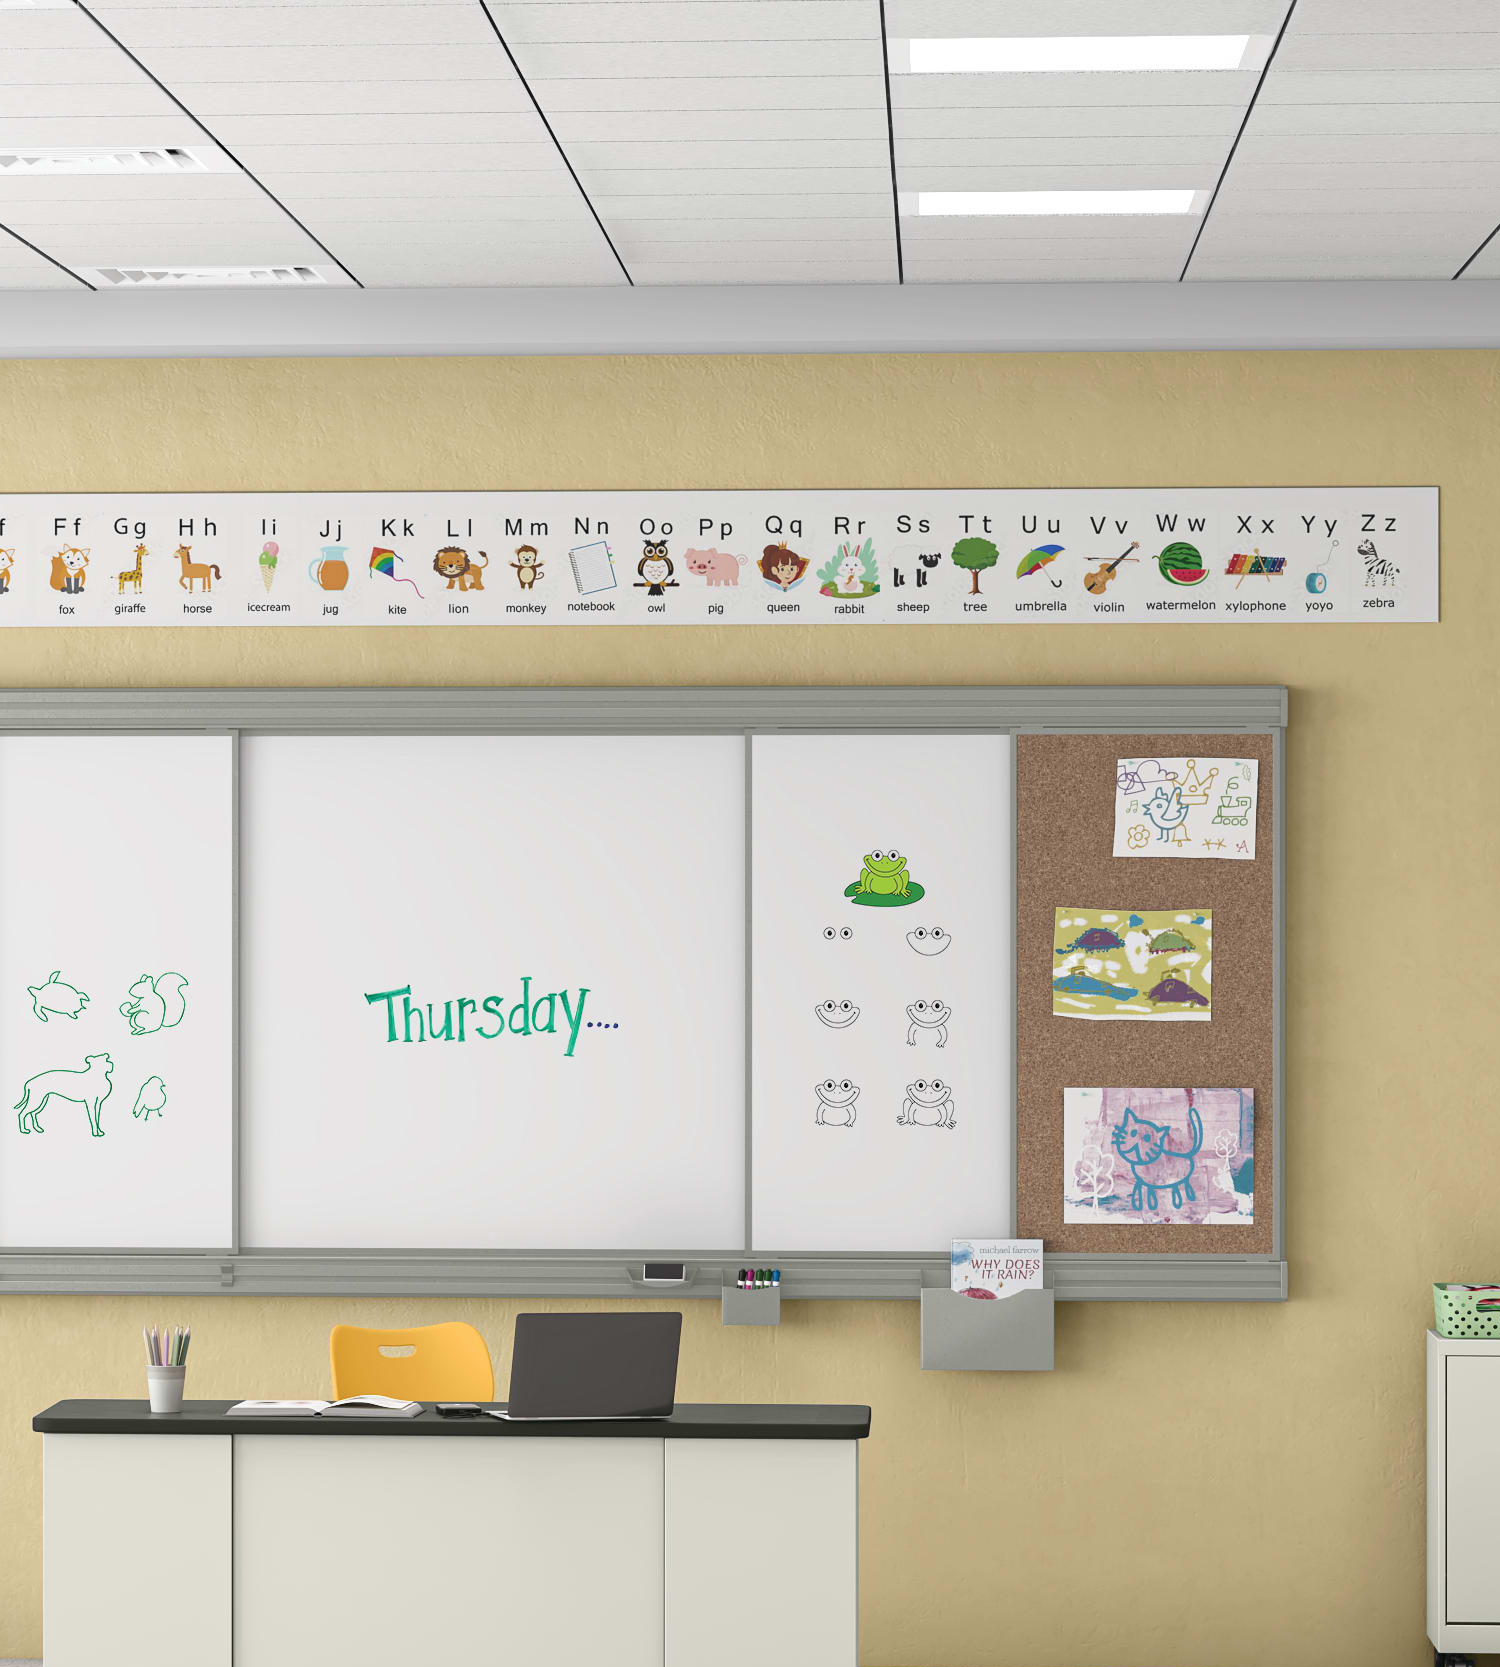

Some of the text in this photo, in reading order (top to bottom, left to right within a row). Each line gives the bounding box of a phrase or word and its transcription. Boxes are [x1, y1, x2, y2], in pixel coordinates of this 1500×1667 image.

[115, 602, 146, 615] giraffe
[183, 604, 212, 613] horse
[248, 603, 290, 612] icecream
[322, 603, 339, 615] jug
[388, 604, 407, 614] kite
[449, 603, 469, 613] lion
[506, 603, 546, 615] monkey
[567, 602, 615, 612] notebook
[648, 602, 665, 612] owl
[708, 603, 724, 615] pig
[767, 604, 800, 614] queen
[897, 602, 930, 614] sheep
[963, 602, 988, 611] tree
[1015, 600, 1067, 611] umbrella
[1094, 602, 1125, 612] violin
[1146, 600, 1216, 610] watermelon
[1226, 601, 1287, 614] xylophone
[1306, 602, 1333, 614] yoyo
[1363, 598, 1395, 609] zebra
[59, 605, 75, 614] fox
[834, 604, 865, 615] rabbit
[971, 1259, 1041, 1270] WHY DOES
[982, 1269, 1035, 1280] IT RAIN?
